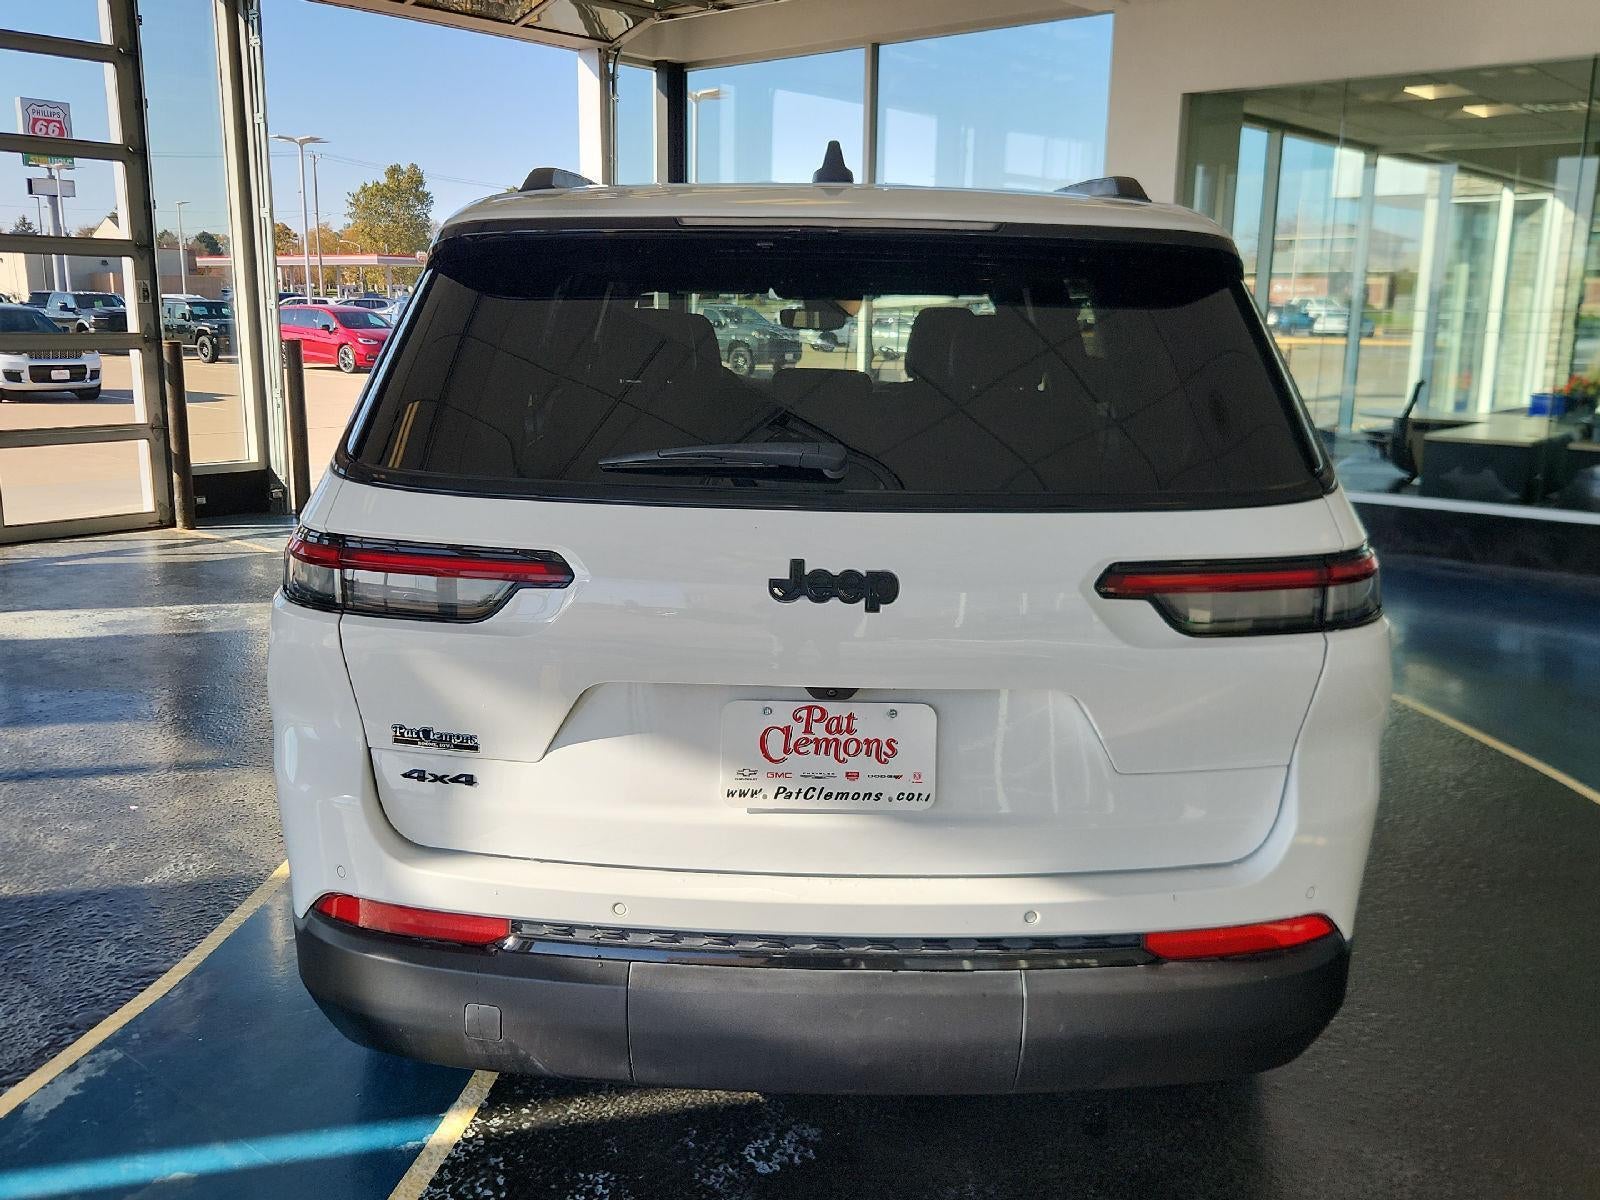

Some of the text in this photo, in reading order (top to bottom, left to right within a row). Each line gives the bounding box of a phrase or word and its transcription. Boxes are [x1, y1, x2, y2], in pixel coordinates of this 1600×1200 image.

[32, 108, 61, 118] PHILLIPS
[35, 120, 60, 136] 66
[768, 558, 900, 613] Jeep
[792, 704, 858, 736] Pat
[391, 723, 478, 745] Pat Clemons
[759, 724, 899, 765] Clemons
[400, 768, 478, 786] 4x4
[766, 771, 793, 779] GMC
